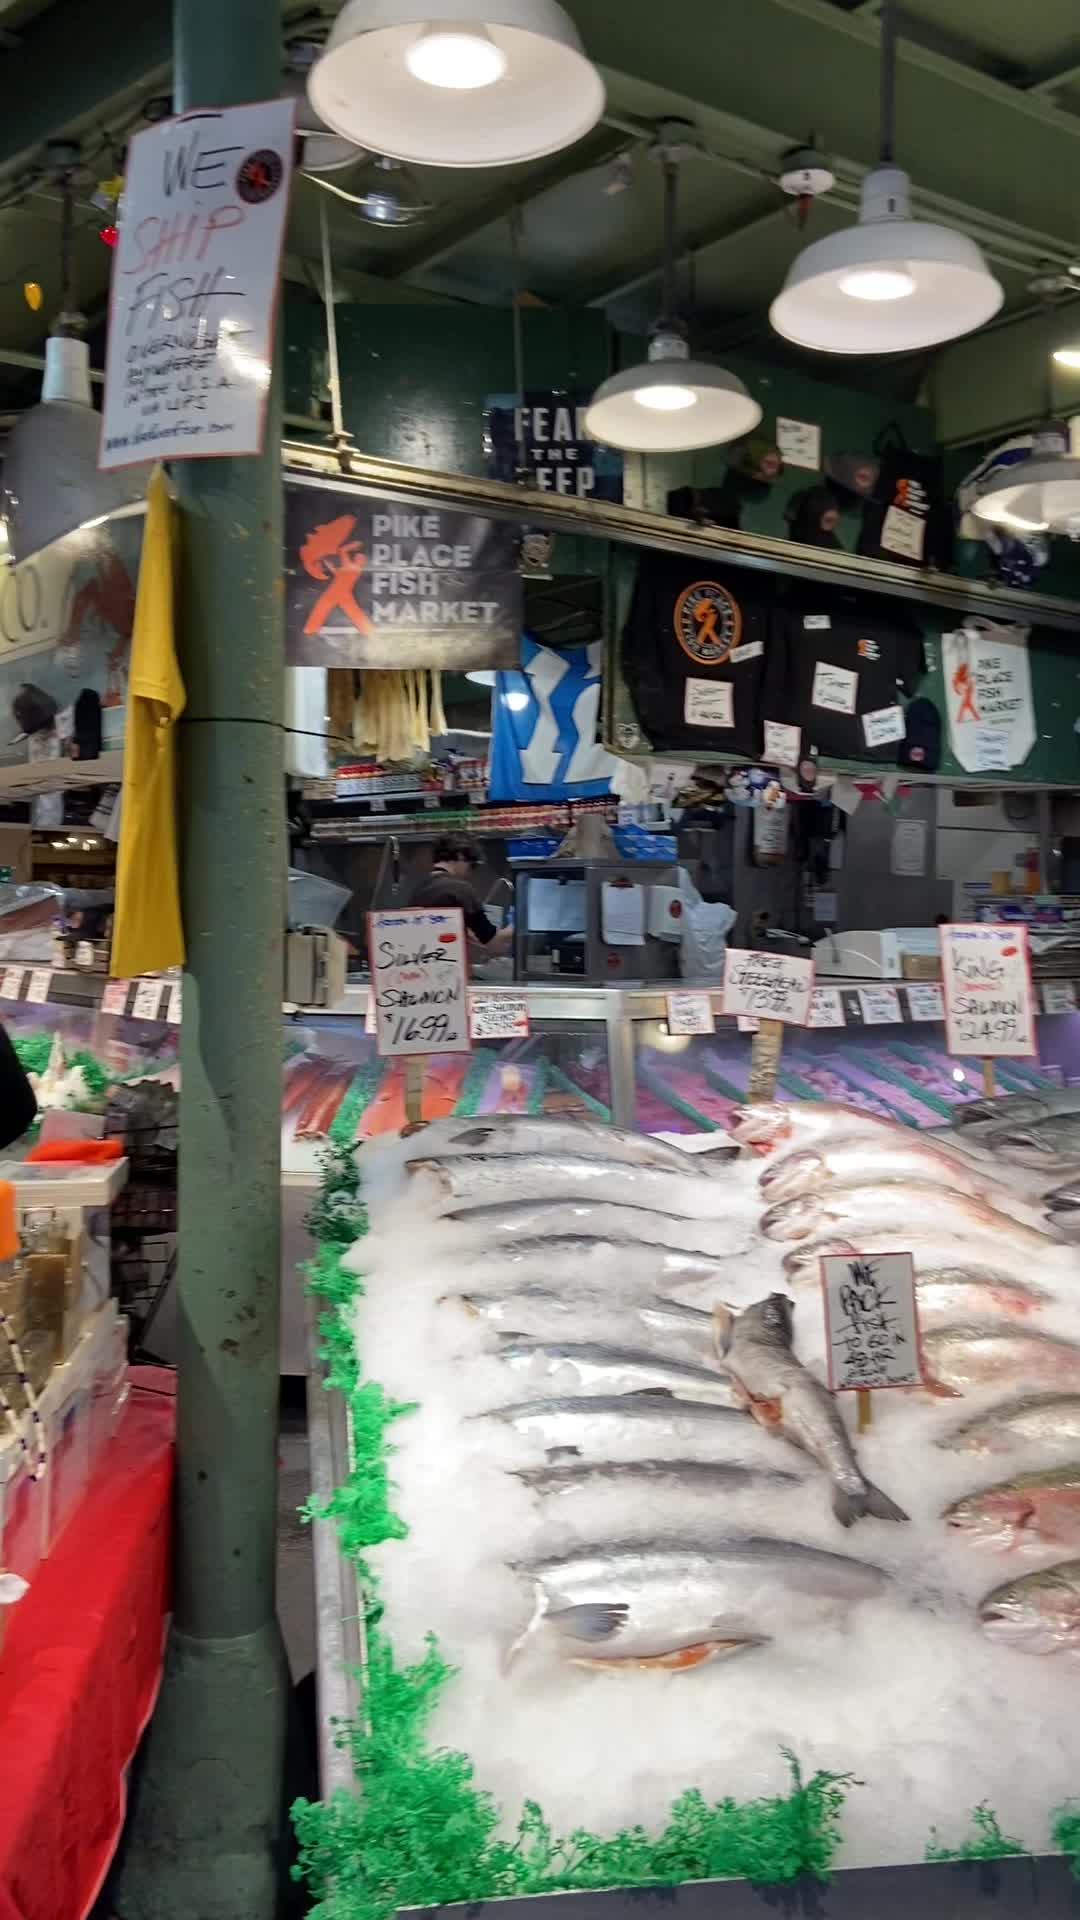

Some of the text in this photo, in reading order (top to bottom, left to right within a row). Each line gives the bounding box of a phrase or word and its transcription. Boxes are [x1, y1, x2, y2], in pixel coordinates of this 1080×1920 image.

[162, 133, 245, 197] WE
[126, 267, 246, 336] FISH
[530, 448, 579, 461] THE
[372, 514, 442, 538] PIKE
[371, 544, 476, 569] PLACE
[372, 572, 441, 596] FISH
[371, 600, 501, 625] MARKET
[376, 979, 461, 1009] SALMON
[952, 995, 1024, 1015] SALMON
